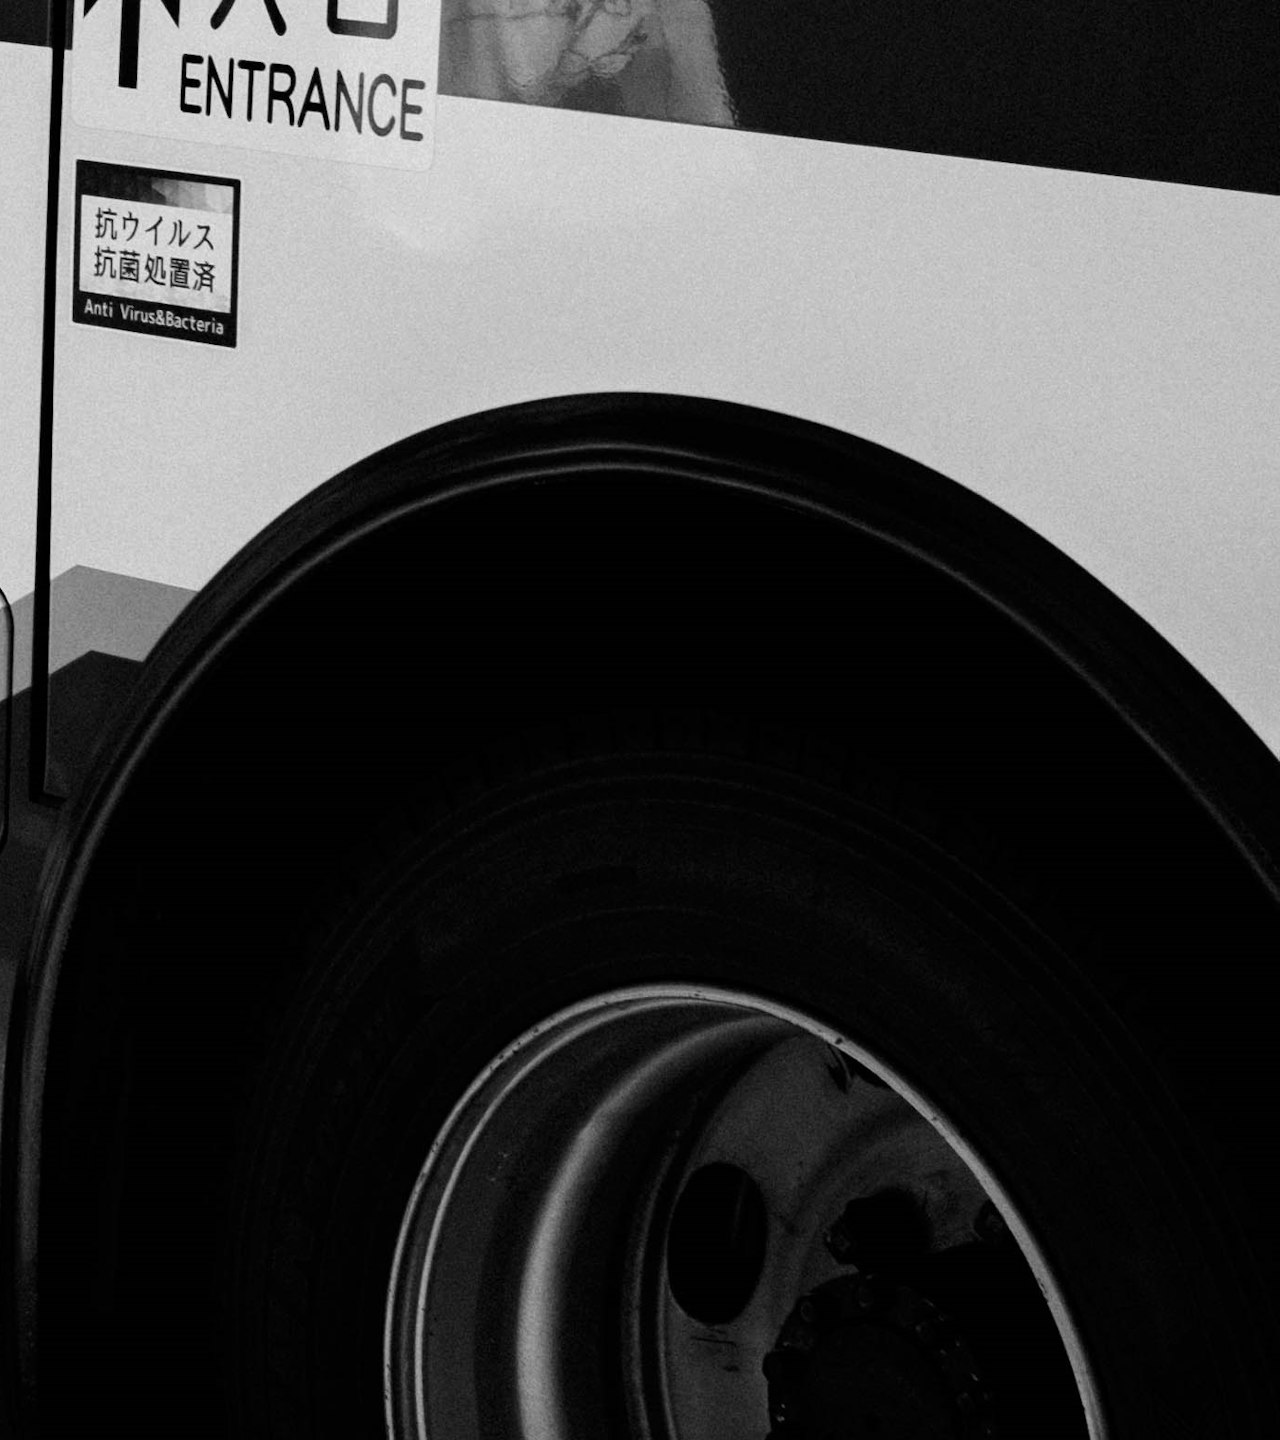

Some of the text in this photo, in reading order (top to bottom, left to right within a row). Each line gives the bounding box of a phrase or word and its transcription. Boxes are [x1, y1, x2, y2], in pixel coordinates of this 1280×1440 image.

[178, 53, 426, 143] ENTRANCE
[95, 207, 214, 250] 抗ウイルス
[94, 246, 215, 293] 抗菌処置済
[84, 299, 224, 335] Anti Virus&Bacteria
